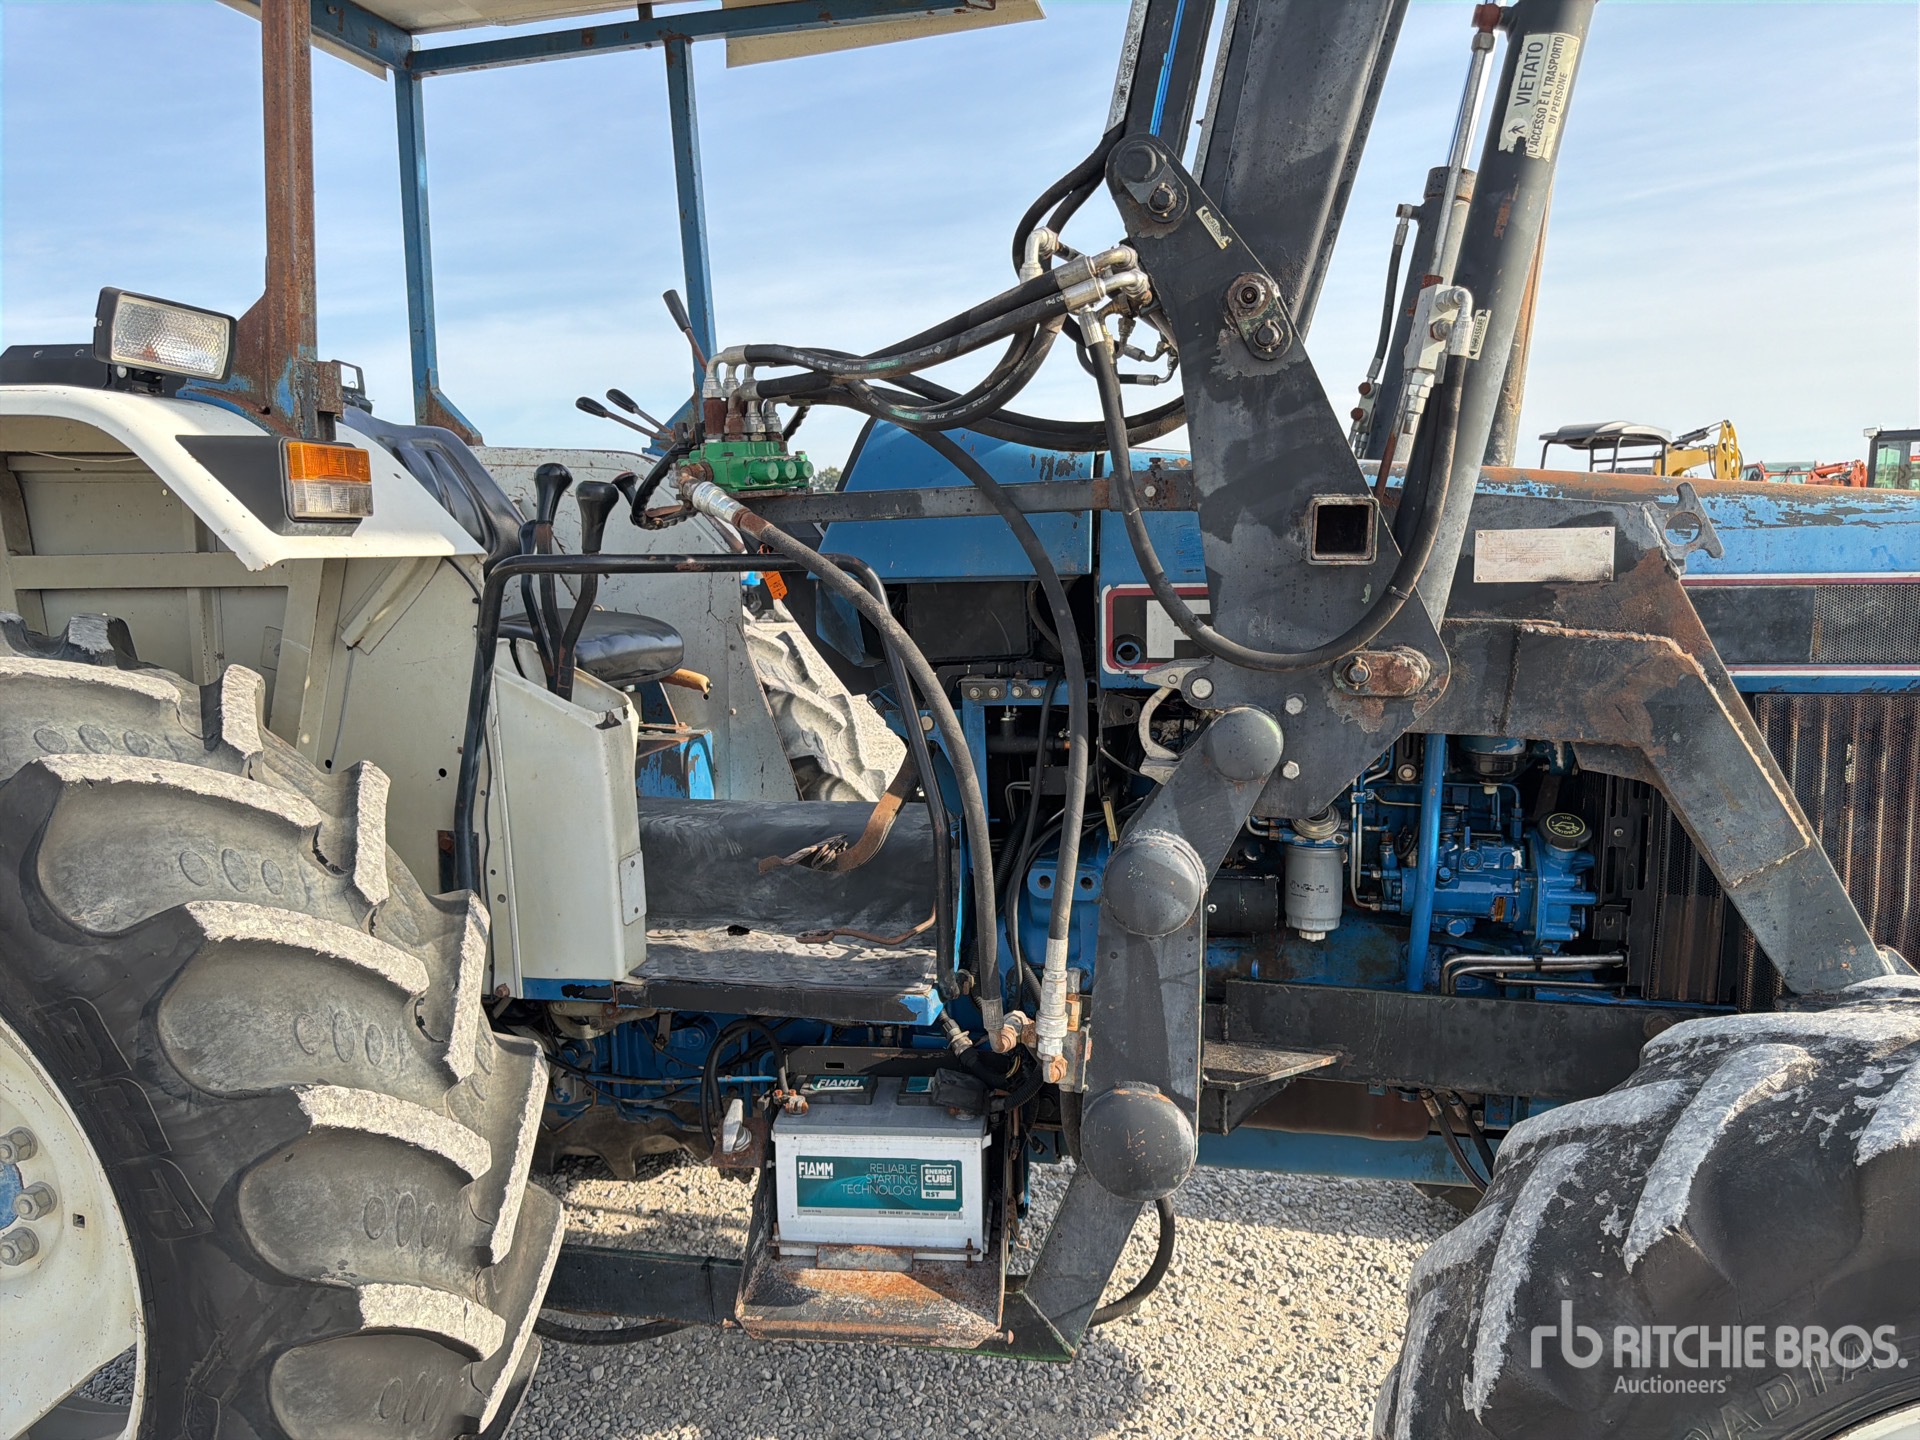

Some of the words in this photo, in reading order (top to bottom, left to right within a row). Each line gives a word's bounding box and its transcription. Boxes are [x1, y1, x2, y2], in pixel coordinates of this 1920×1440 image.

[1544, 36, 1565, 87] TRASPORTO
[1514, 42, 1544, 106] VIETATO
[1544, 90, 1552, 98] IL
[1551, 72, 1568, 113] PERSONE
[1548, 115, 1558, 125] DI
[1528, 107, 1548, 154] L'ACCESSO
[817, 1078, 860, 1088] FIAMM
[799, 1161, 834, 1177] FIAMM
[870, 1163, 917, 1175] RELIABLE
[866, 1173, 918, 1185] STARTING
[925, 1175, 953, 1184] CUBE
[841, 1184, 918, 1196] TECHNOLOGY
